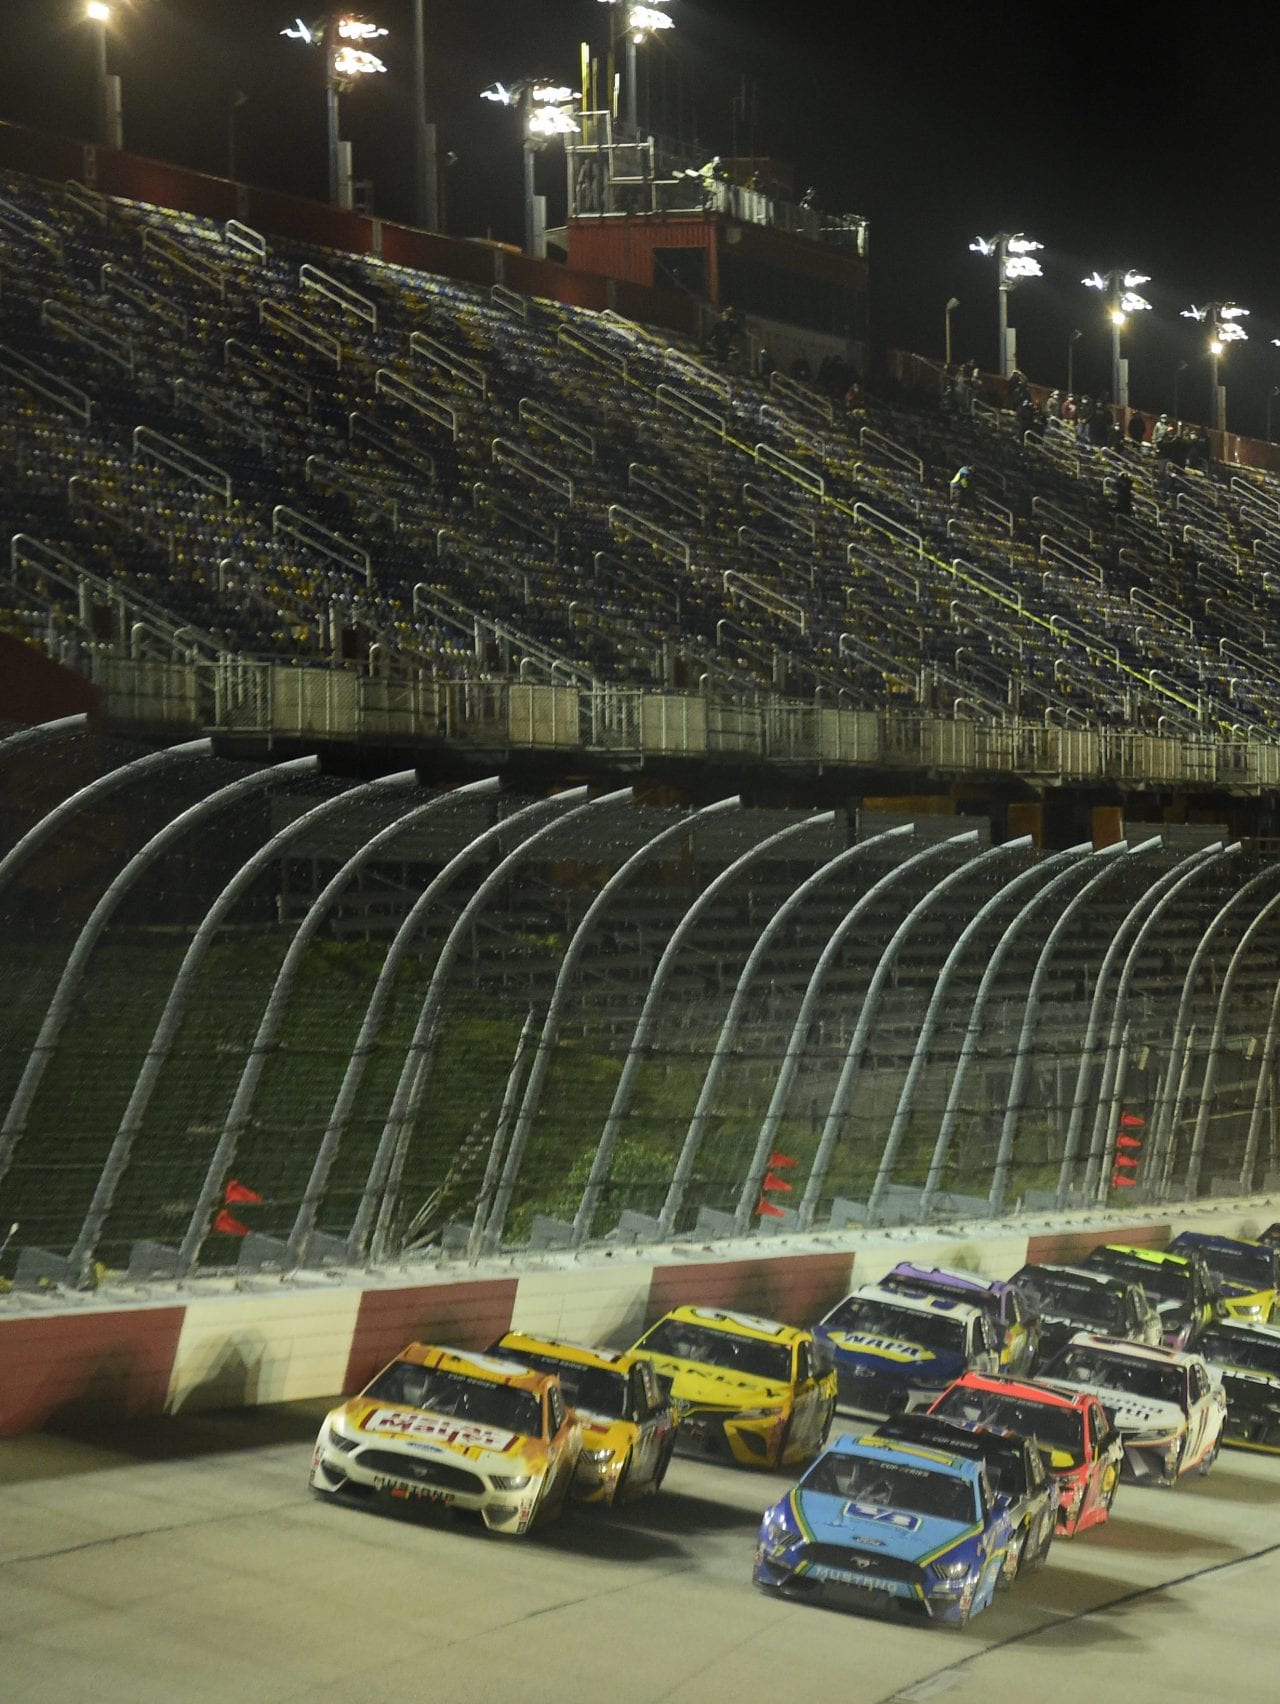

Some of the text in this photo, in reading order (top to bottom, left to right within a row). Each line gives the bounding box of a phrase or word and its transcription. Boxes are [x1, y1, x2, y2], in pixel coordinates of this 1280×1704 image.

[845, 1335, 919, 1357] NAPA
[374, 1476, 456, 1503] MUSTANG
[816, 1564, 897, 1593] MUSTANG
